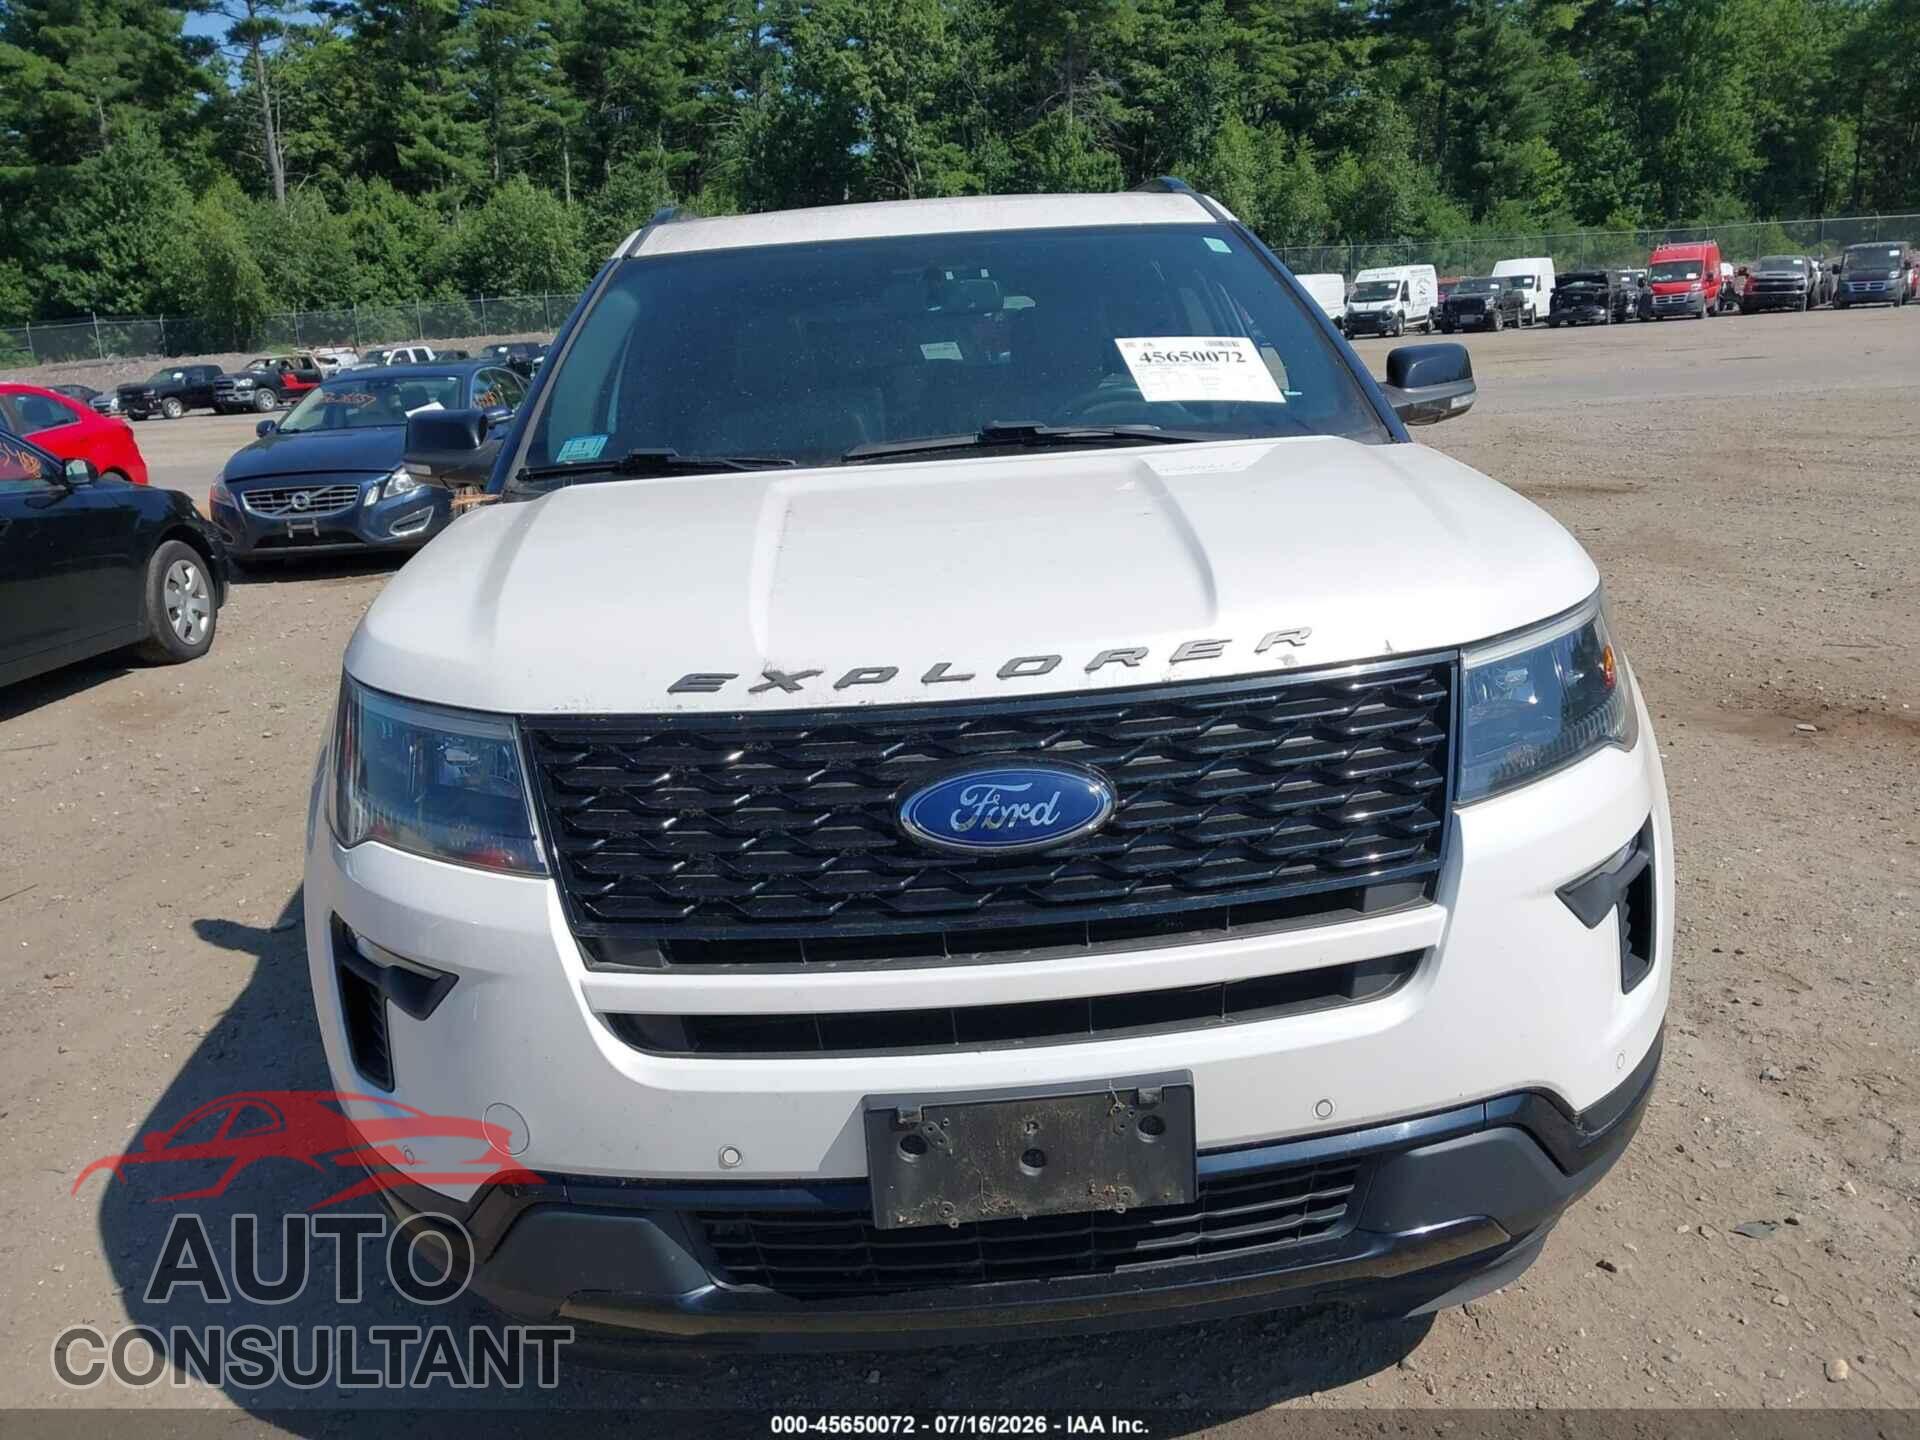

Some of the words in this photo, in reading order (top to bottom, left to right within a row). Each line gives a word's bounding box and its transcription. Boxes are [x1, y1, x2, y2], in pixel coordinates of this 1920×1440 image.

[1138, 351, 1247, 364] 45650072
[667, 626, 1312, 694] EXPLORER
[950, 783, 1061, 832] Ford
